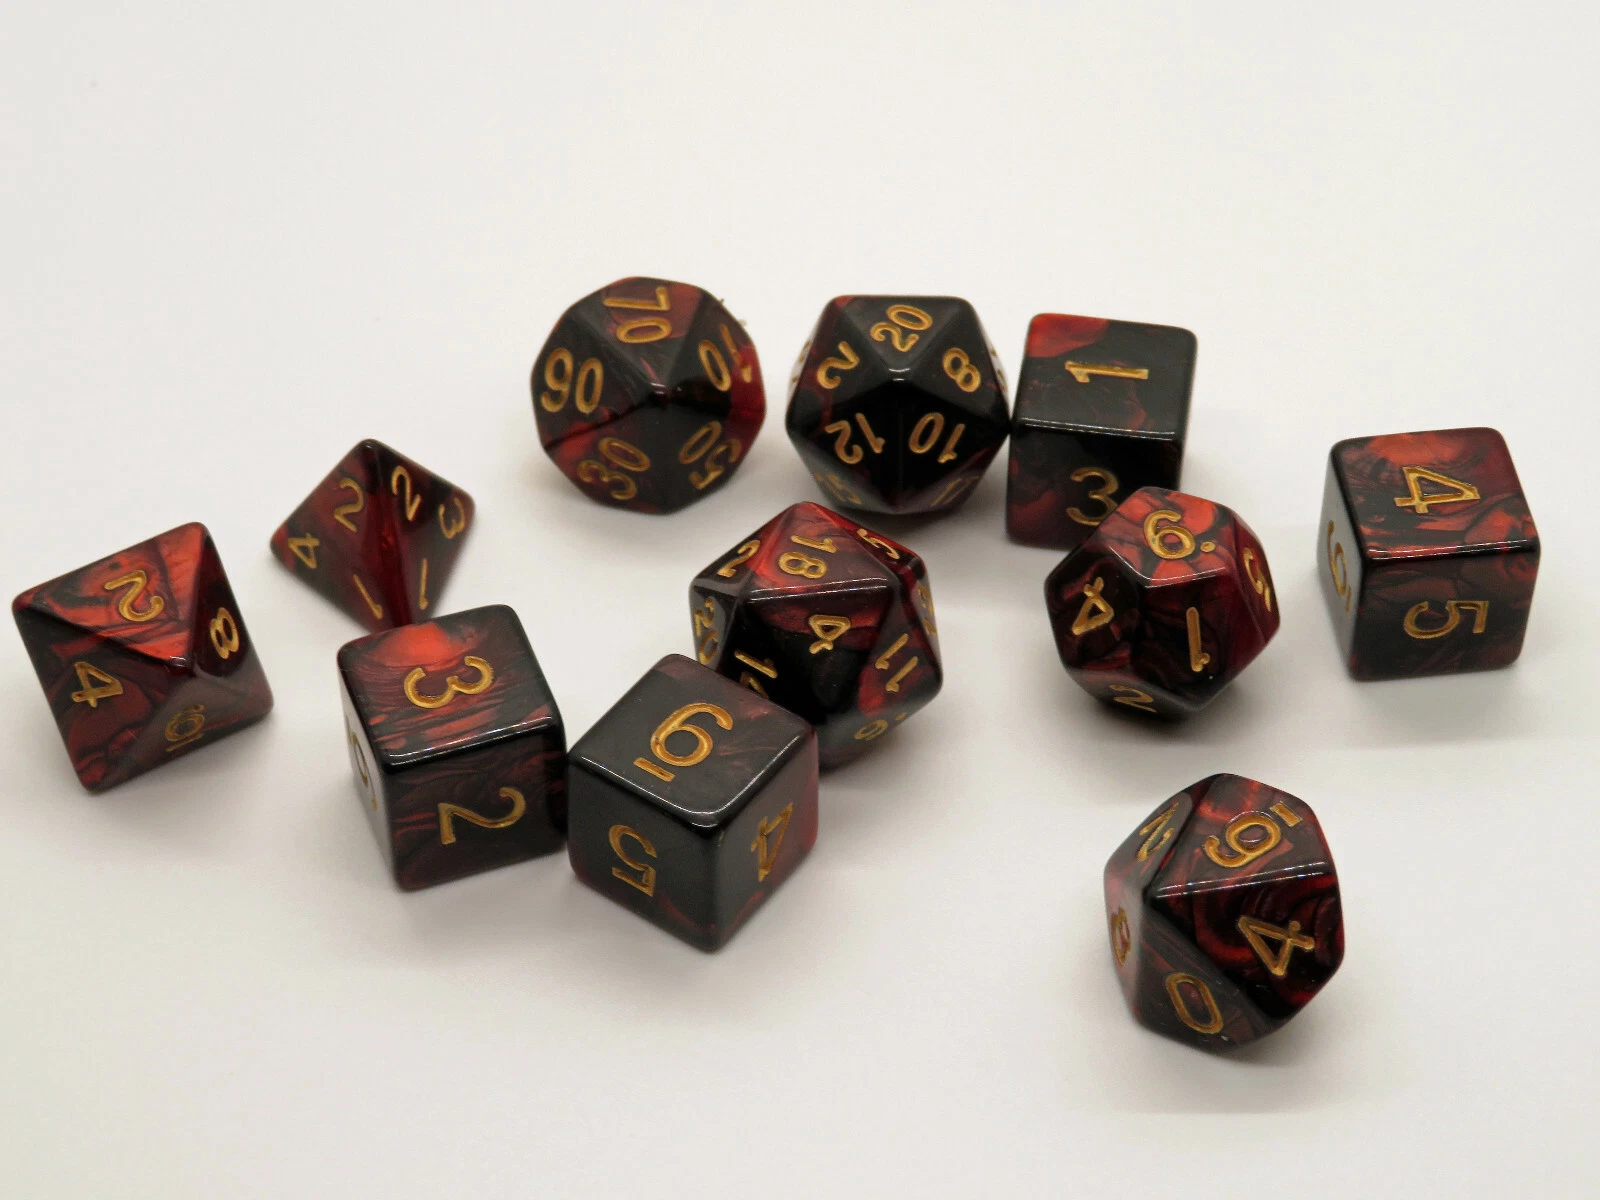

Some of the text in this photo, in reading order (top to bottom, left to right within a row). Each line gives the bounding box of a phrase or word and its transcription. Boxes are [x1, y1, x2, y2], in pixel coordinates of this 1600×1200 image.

[603, 286, 673, 344] 70
[870, 304, 933, 352] 20
[541, 347, 604, 414] 90
[816, 341, 860, 390] 2
[942, 347, 982, 393] 8
[1064, 360, 1150, 383] 1
[679, 421, 742, 490] 50
[825, 413, 886, 464] 12
[909, 413, 966, 464] 10
[391, 466, 421, 521] 2
[577, 437, 651, 500] 30
[1393, 466, 1481, 514] 4
[334, 478, 364, 533] 2
[438, 498, 466, 540] 3
[1065, 467, 1119, 527] 3
[288, 532, 320, 569] 4
[717, 540, 760, 577] 2
[778, 535, 838, 579] 18
[104, 570, 164, 622] 2
[353, 574, 382, 619] 1
[418, 557, 429, 610] 1
[1071, 576, 1115, 636] 4
[1242, 547, 1272, 612] 5
[209, 606, 240, 660] 8
[808, 614, 851, 654] 4
[1186, 606, 1211, 672] 1
[1403, 600, 1489, 639] 5
[71, 661, 124, 708] 4
[403, 655, 495, 710] 3
[875, 633, 919, 693] 11
[1109, 684, 1157, 712] 2
[438, 787, 526, 845] 2
[750, 802, 793, 882] 4
[1138, 803, 1180, 862] 2
[608, 824, 657, 897] 5
[1238, 916, 1315, 976] 4
[1165, 972, 1223, 1034] 0
